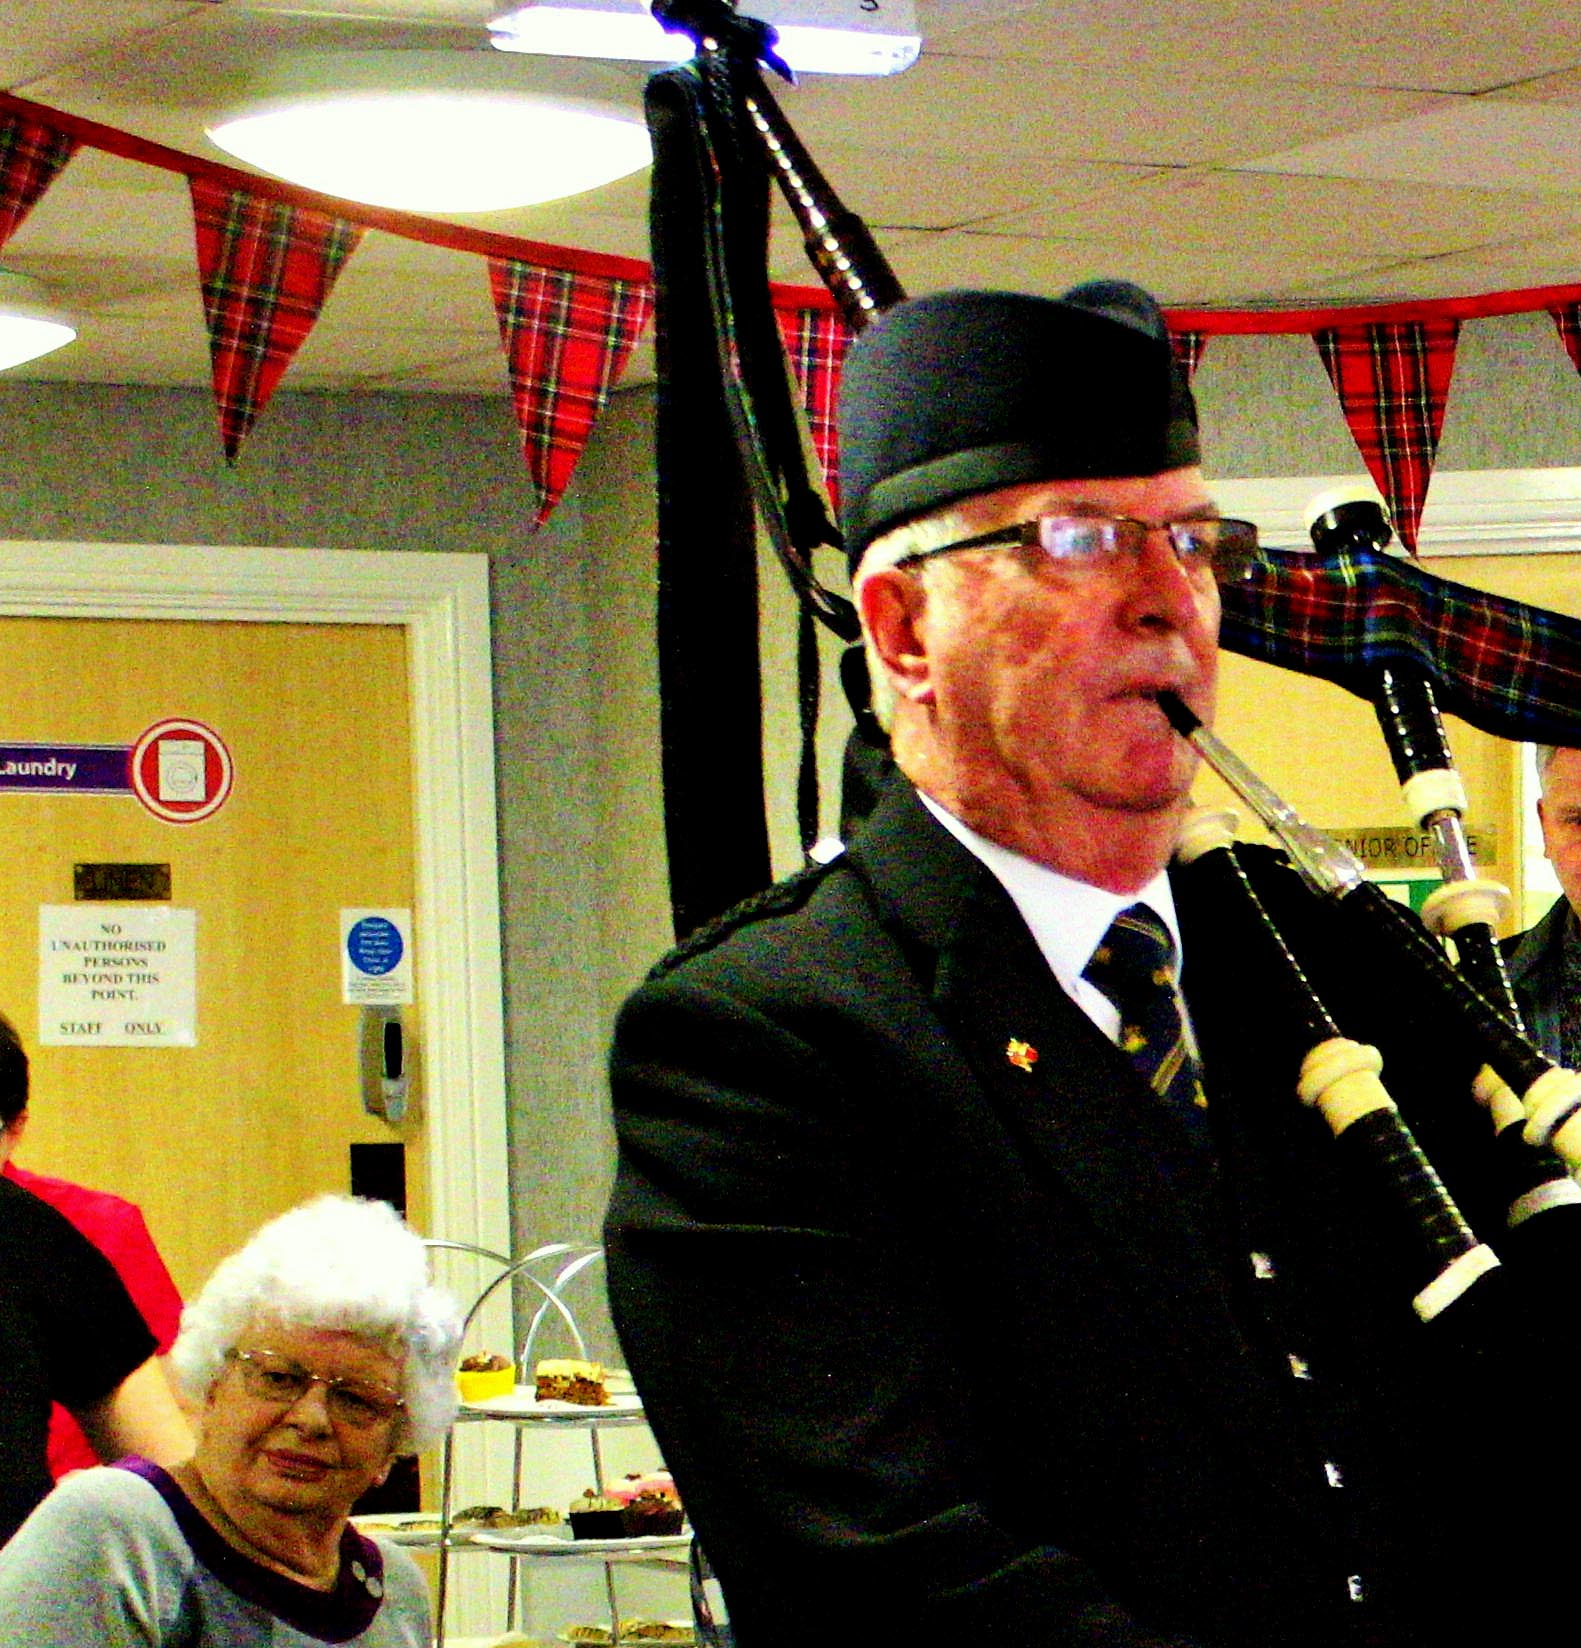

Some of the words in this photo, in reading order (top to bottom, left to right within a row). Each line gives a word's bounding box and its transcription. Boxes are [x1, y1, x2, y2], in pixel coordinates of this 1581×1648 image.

[100, 923, 122, 934] NO
[51, 940, 167, 952] UNAUTHORISED
[83, 957, 149, 968] PERSONS
[62, 973, 123, 985] BEYOND
[127, 973, 161, 984] THIS
[60, 1022, 103, 1035] STAFF
[124, 1022, 164, 1035] ONLY
